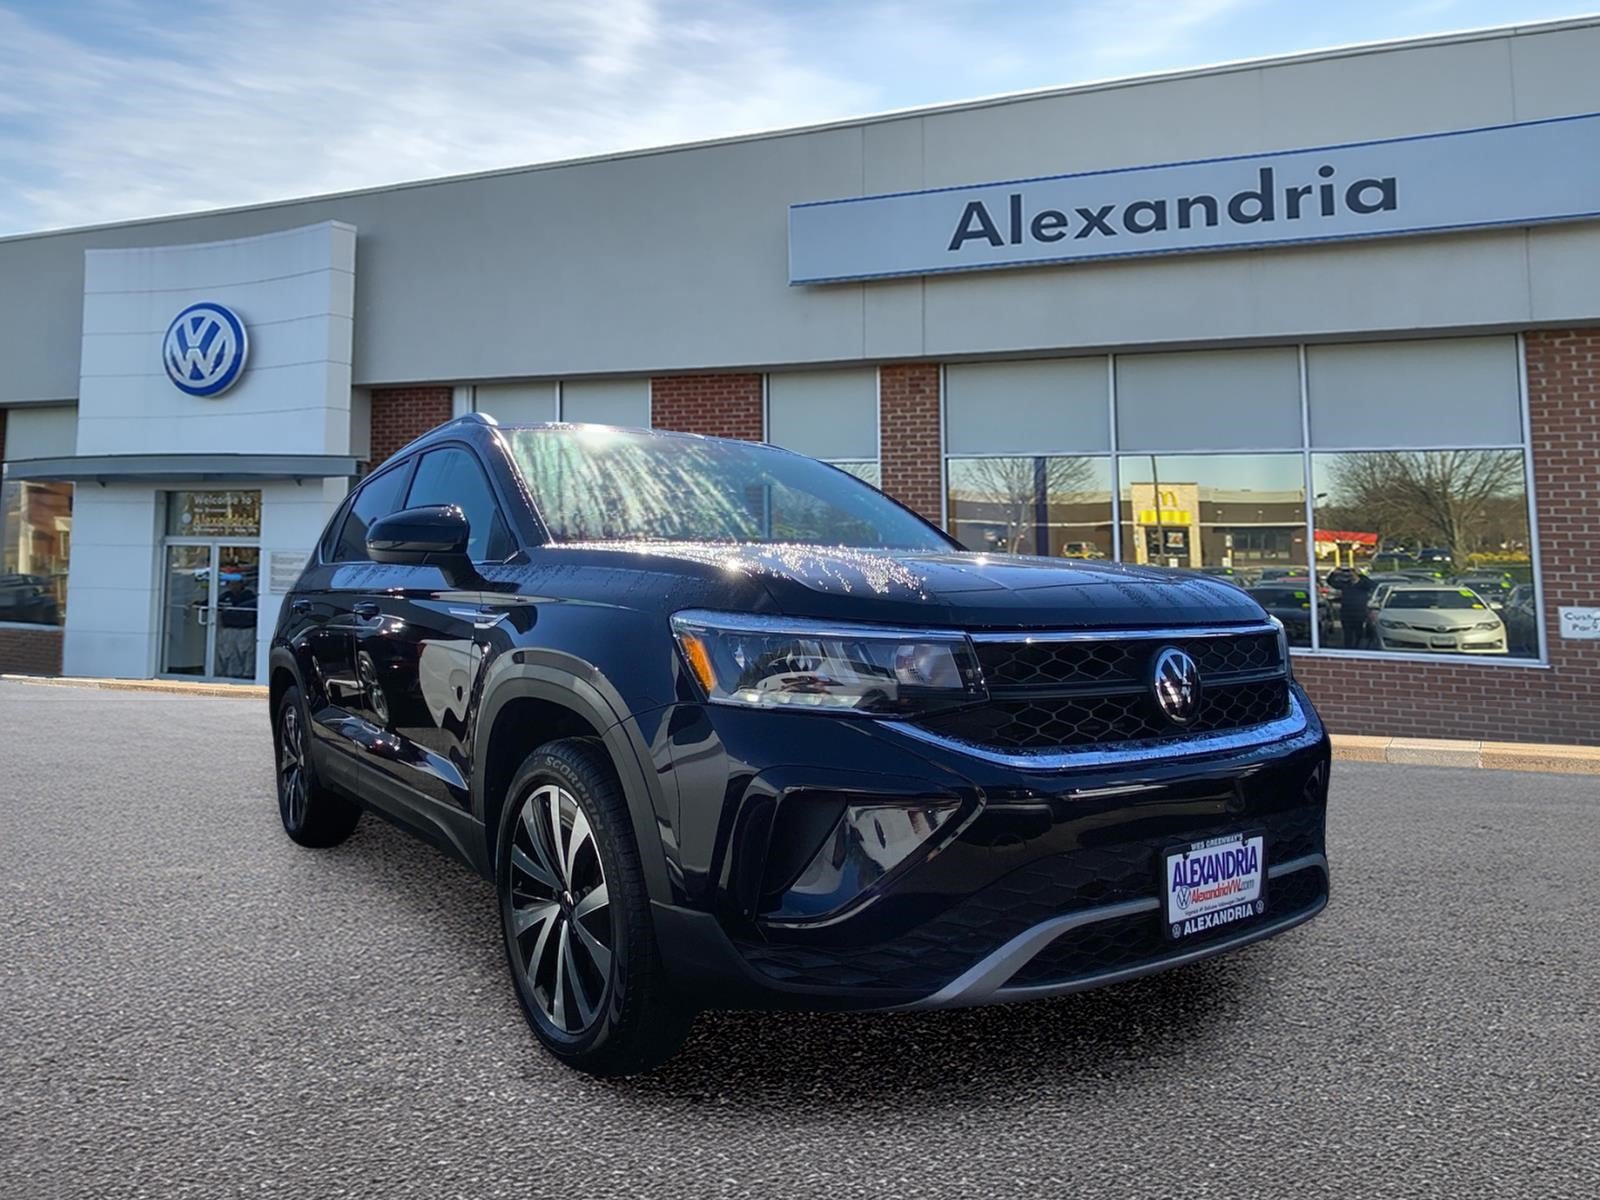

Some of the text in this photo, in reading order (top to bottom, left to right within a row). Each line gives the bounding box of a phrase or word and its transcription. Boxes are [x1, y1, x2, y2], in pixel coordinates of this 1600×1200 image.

[947, 164, 1399, 252] Alexandria
[1172, 846, 1258, 892] ALEXANDRIA
[1184, 903, 1254, 936] ALEXANDRIA
